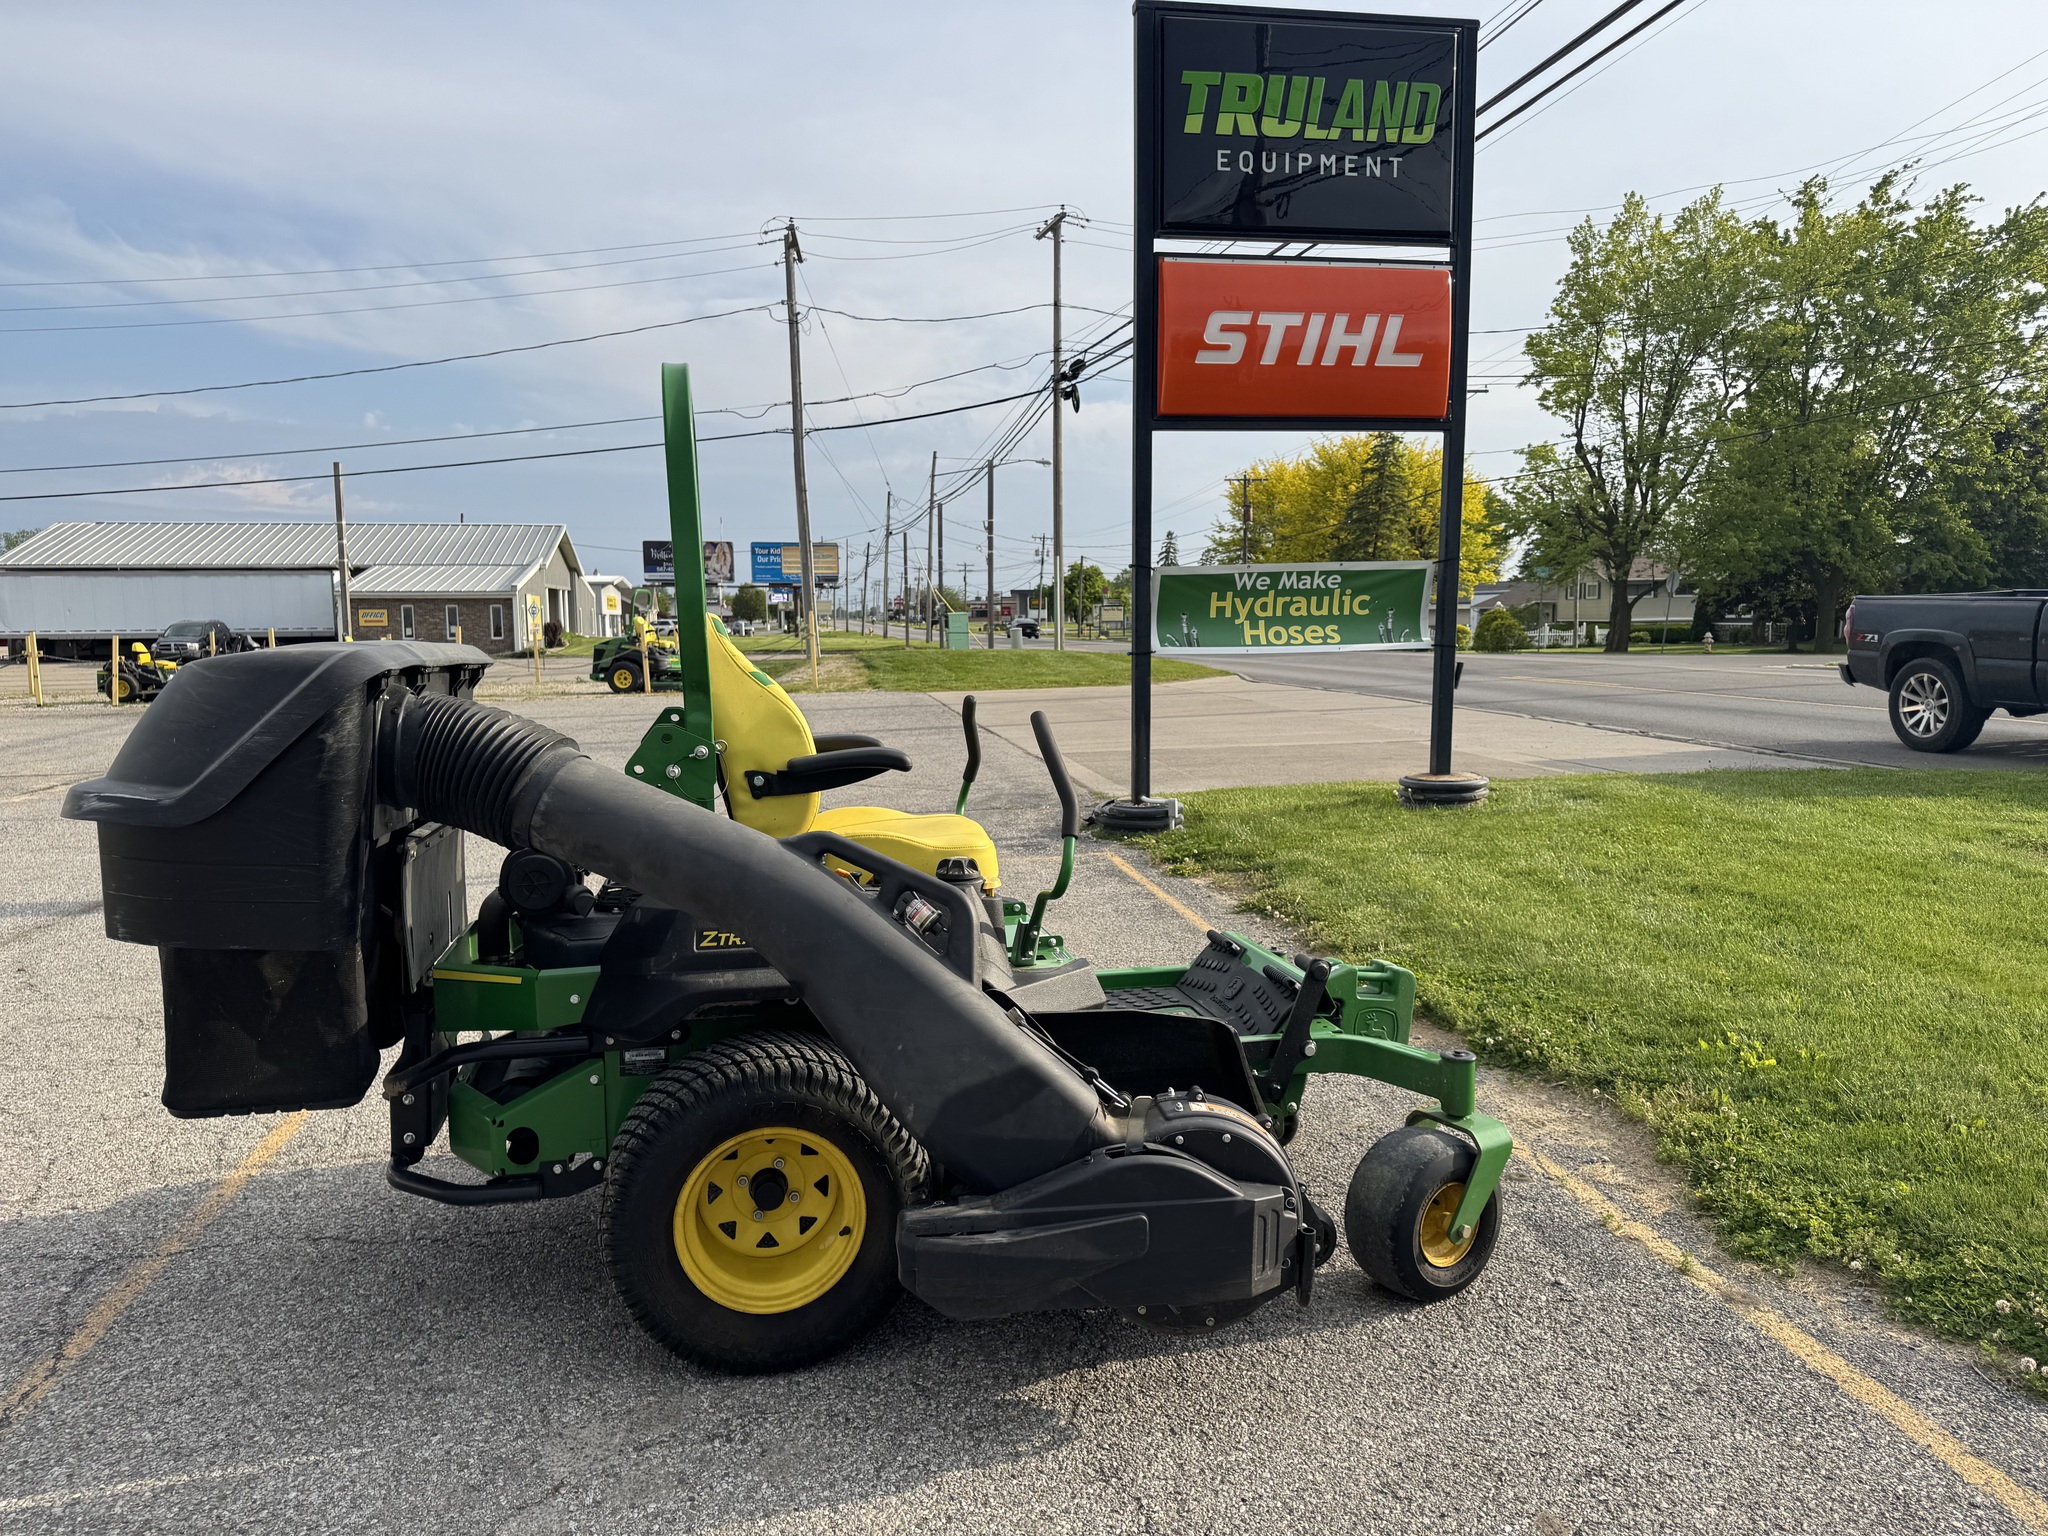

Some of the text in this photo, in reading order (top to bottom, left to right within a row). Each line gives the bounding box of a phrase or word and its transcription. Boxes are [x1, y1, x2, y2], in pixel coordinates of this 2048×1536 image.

[1181, 70, 1442, 145] TRULAND
[1216, 149, 1404, 179] EQUIPMENT
[1195, 310, 1424, 368] STIHL
[757, 555, 769, 563] Our
[1234, 570, 1342, 591] We Make
[1209, 588, 1371, 625] Hydraulic
[1243, 619, 1341, 646] Hoses
[1856, 633, 1879, 643] Z71
[699, 930, 746, 947] ZTR
